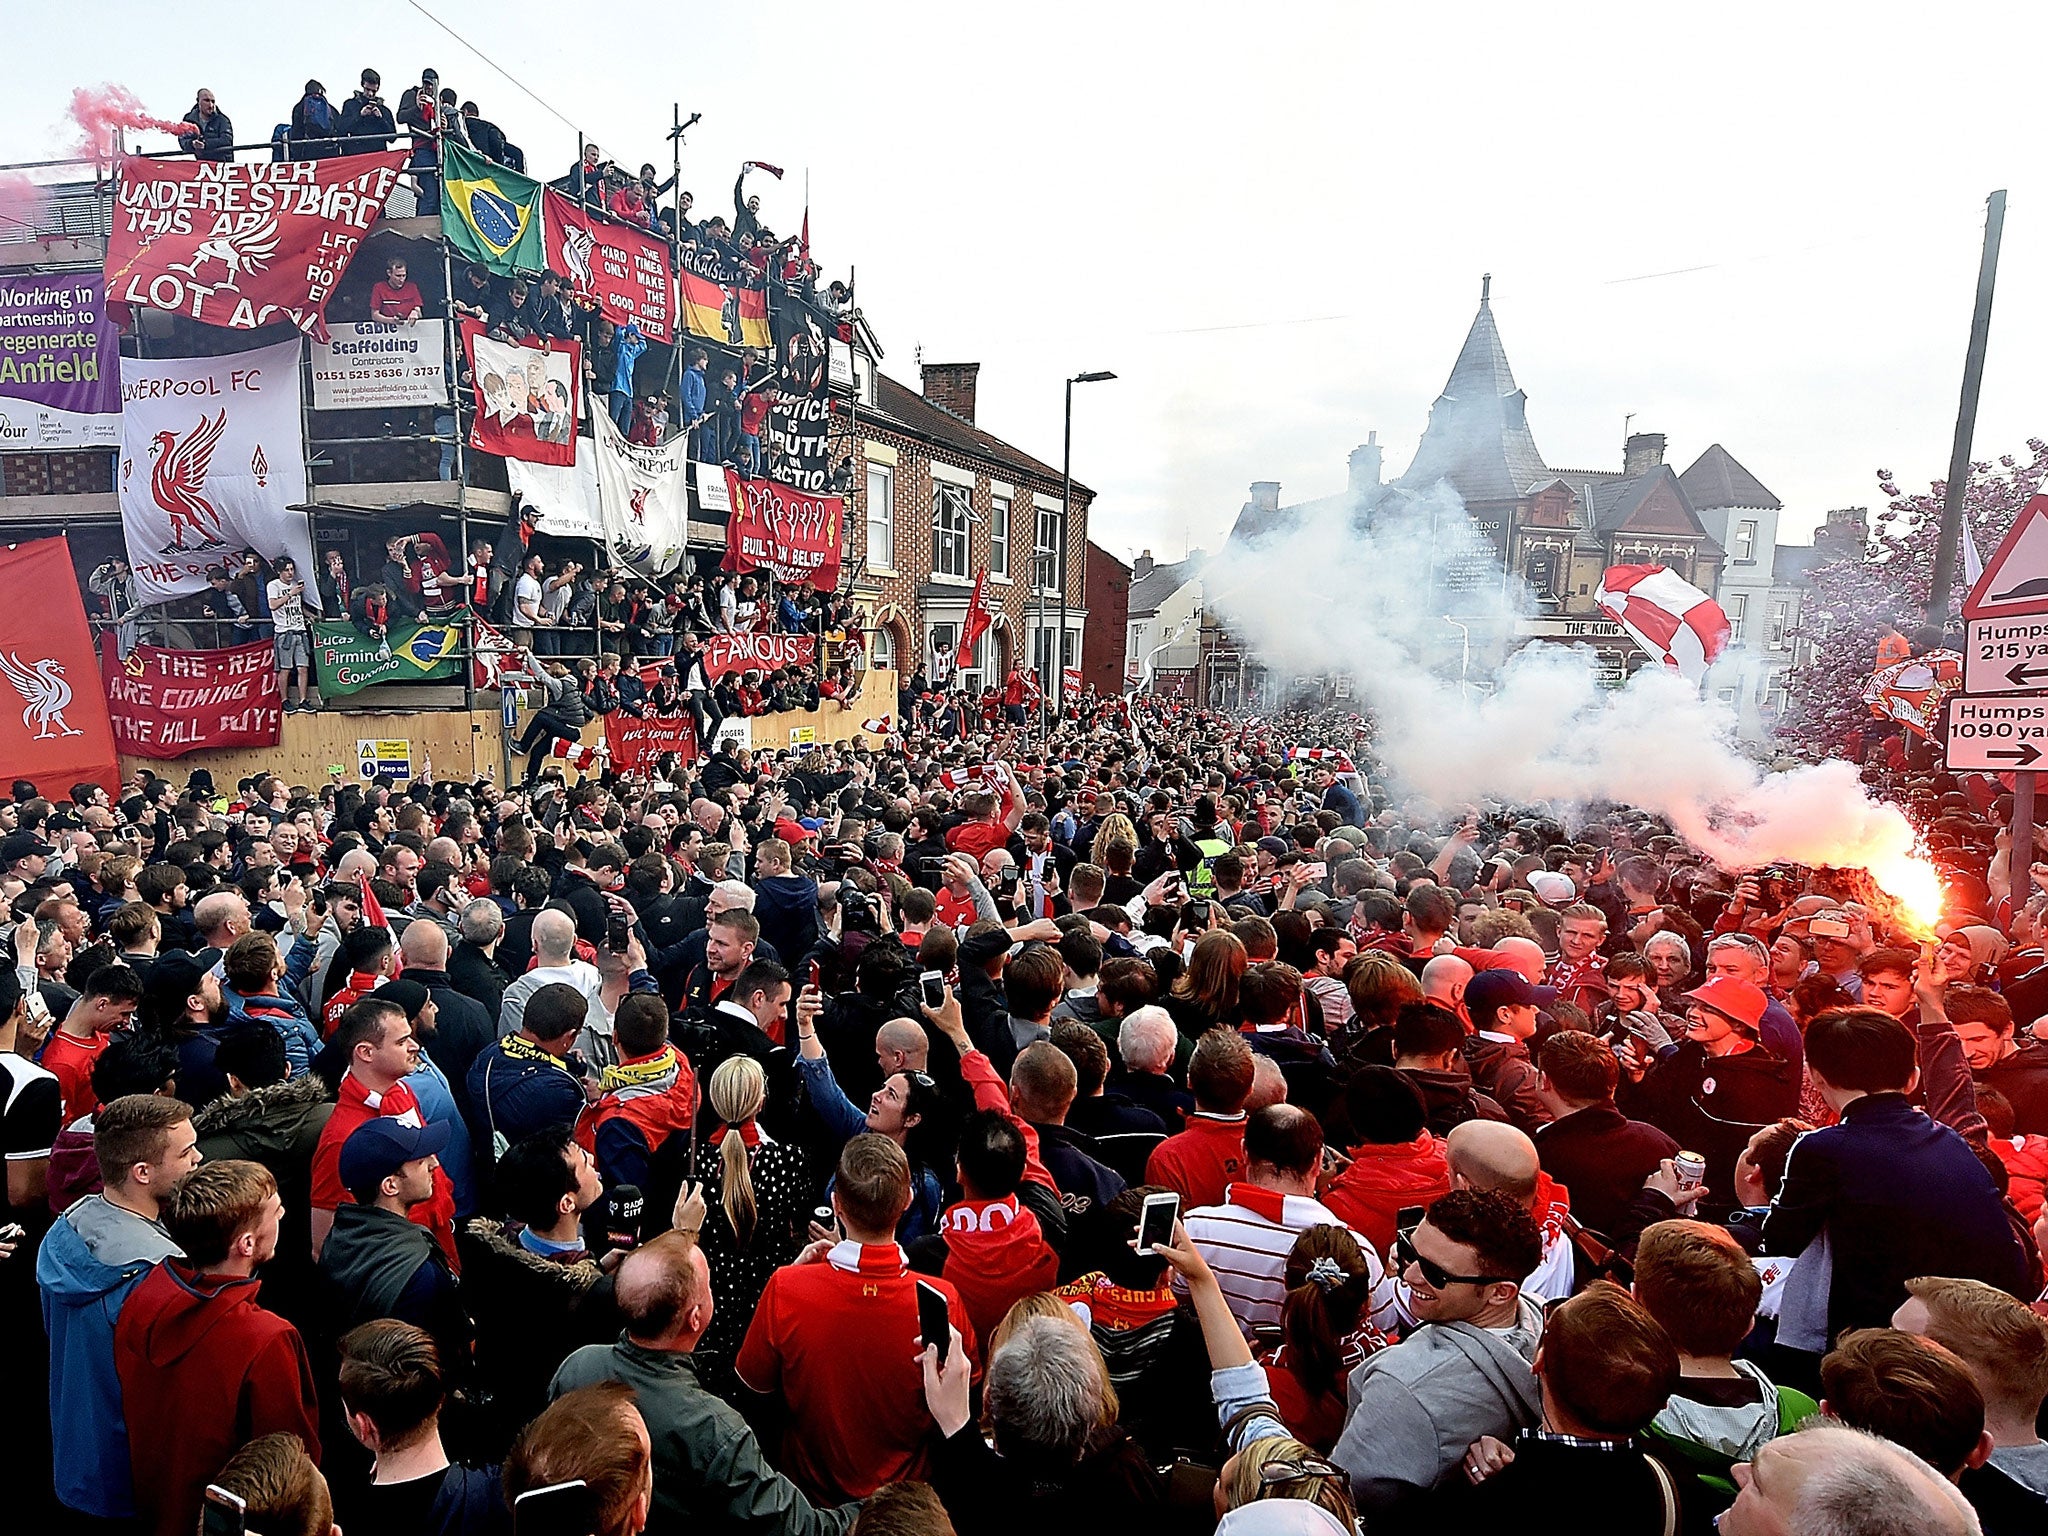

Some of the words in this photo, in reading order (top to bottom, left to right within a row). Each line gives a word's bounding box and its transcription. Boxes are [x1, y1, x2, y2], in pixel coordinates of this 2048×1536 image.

[193, 160, 317, 184] NEVER
[125, 206, 193, 236] THIS
[601, 245, 627, 264] HARD
[634, 254, 664, 276] TIMES
[640, 244, 661, 263] THE
[604, 261, 629, 280] ONLY
[636, 271, 666, 290] MAKE
[0, 285, 72, 309] Working
[75, 285, 93, 304] in
[124, 273, 216, 319] LOT
[645, 289, 666, 306] THE
[609, 293, 634, 311] GOOD
[640, 303, 666, 320] ONES
[78, 310, 95, 324] to
[354, 320, 398, 335] Gable
[331, 339, 418, 356] Scaffolding
[0, 352, 99, 384] Anfield
[351, 357, 405, 367] Contractors
[231, 369, 261, 391] FC
[315, 371, 345, 381] 0151
[349, 371, 371, 380] 525
[374, 368, 403, 379] 3636
[413, 366, 441, 376] 3737
[787, 419, 798, 433] IS
[1471, 521, 1500, 531] KING
[742, 535, 774, 558] BUILT
[791, 548, 826, 568] BELIEF
[135, 561, 185, 584] THE
[1565, 622, 1587, 635] THE
[1592, 623, 1619, 635] KING
[314, 632, 355, 649] Lucas
[711, 632, 798, 668] FAMOUS
[1981, 643, 2020, 660] 215
[156, 652, 208, 679] THE
[1602, 671, 1620, 680] Sport
[108, 676, 153, 706] ARE
[159, 677, 251, 711] COMING
[1960, 704, 2045, 721] Humps
[110, 714, 154, 742] THE
[159, 717, 207, 744] HILL
[678, 726, 692, 741] it
[720, 728, 745, 738] ROGERS
[379, 765, 397, 773] Keep
[396, 765, 408, 773] out
[623, 1206, 642, 1218] CITY
